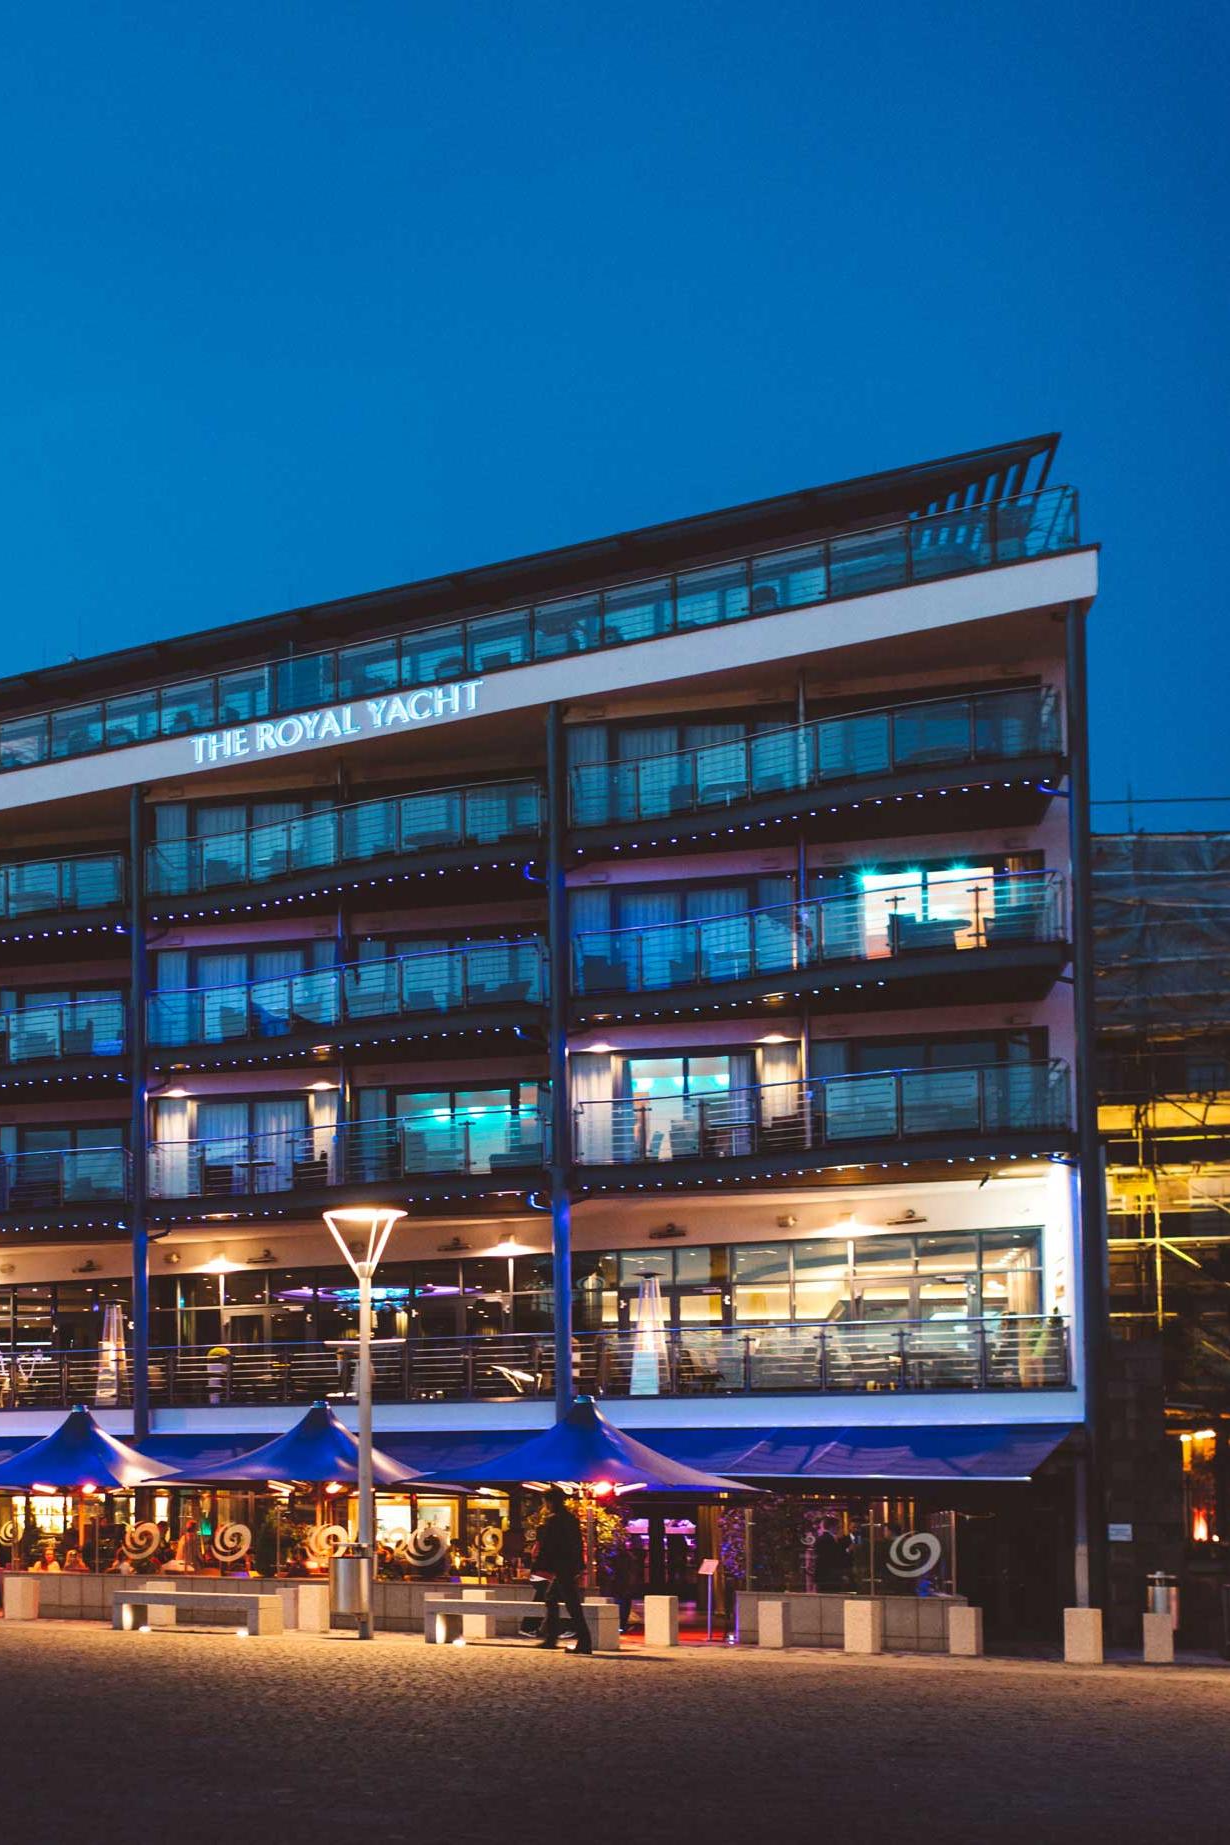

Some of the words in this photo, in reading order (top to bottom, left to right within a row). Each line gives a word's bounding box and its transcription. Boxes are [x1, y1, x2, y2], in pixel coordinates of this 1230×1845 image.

[190, 727, 250, 764] THE
[256, 704, 361, 752] ROYAL
[368, 680, 484, 728] YACHT
